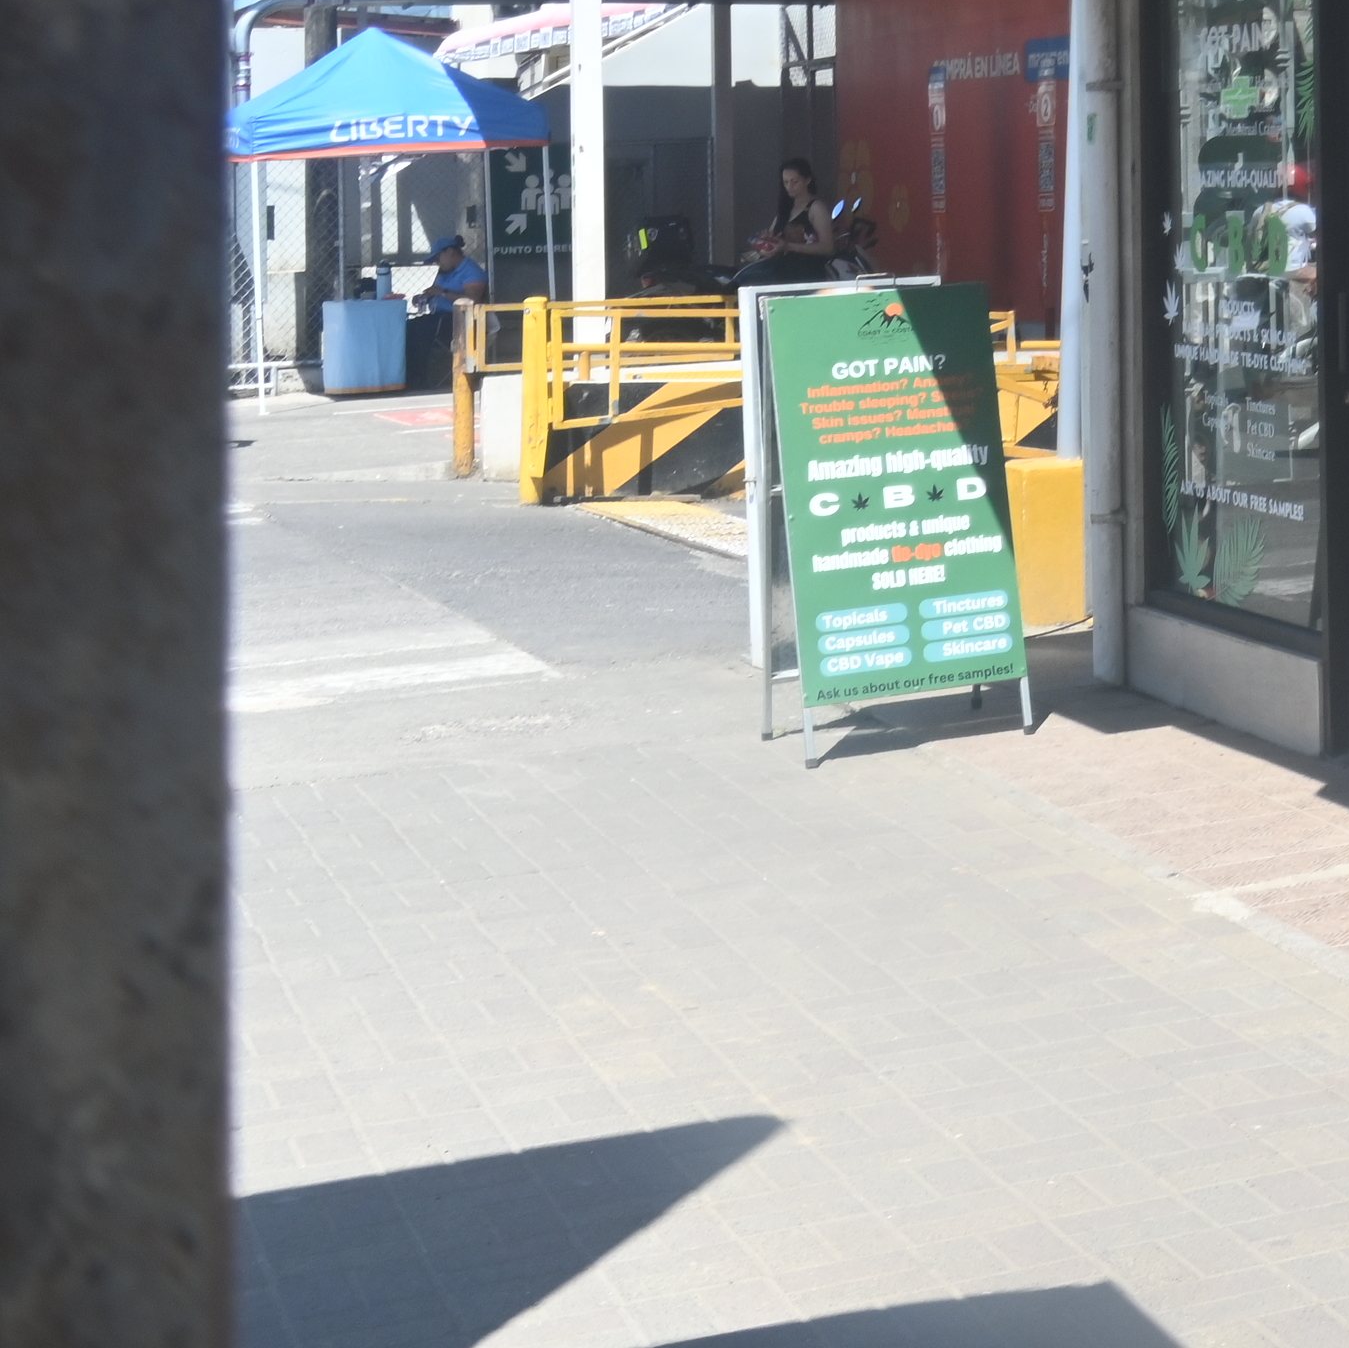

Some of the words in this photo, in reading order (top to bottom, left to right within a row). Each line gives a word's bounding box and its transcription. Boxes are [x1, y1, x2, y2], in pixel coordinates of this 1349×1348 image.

[330, 115, 474, 143] LIBERTY
[493, 245, 532, 254] PUNTO
[1228, 216, 1245, 274] B
[1267, 213, 1288, 276] D
[831, 358, 879, 380] GOT
[884, 354, 946, 376] PAIN?
[807, 378, 909, 398] Inflammation?
[800, 398, 856, 415] Trouble
[859, 392, 928, 410] sleeping?
[1246, 396, 1276, 416] Tinctures
[812, 415, 845, 430] Skin
[848, 409, 904, 427] issues?
[1258, 422, 1275, 438] CBD
[819, 427, 882, 444] cramps?
[807, 454, 882, 482] Amazing
[885, 443, 988, 473] high-quality
[1247, 442, 1276, 462] Skincare
[809, 492, 840, 517] C
[883, 484, 915, 509] B
[956, 476, 987, 501] D
[1206, 485, 1232, 502] ABOUT
[1232, 491, 1248, 509] OUR
[1250, 494, 1267, 513] FREE
[1268, 498, 1304, 522] SAMPLES!
[841, 520, 907, 547] products
[909, 520, 920, 537] &
[921, 513, 971, 535] unique
[812, 547, 889, 573] handmade
[944, 534, 1003, 557] clothing
[872, 570, 907, 591] SOLD
[909, 564, 946, 586] HERE!
[933, 593, 1005, 616] Tinctures
[822, 609, 888, 631] Topicals
[943, 619, 968, 635] Pet
[972, 614, 1006, 631] CBD
[825, 630, 895, 652] Capsules
[942, 636, 1007, 657] Skincare
[827, 655, 862, 673] CBD
[864, 651, 905, 669] Vape
[816, 686, 841, 701] Ask
[844, 686, 859, 697] us
[861, 679, 901, 694] about
[904, 676, 926, 688] our
[929, 671, 955, 686] free
[957, 663, 1015, 682] samples!
